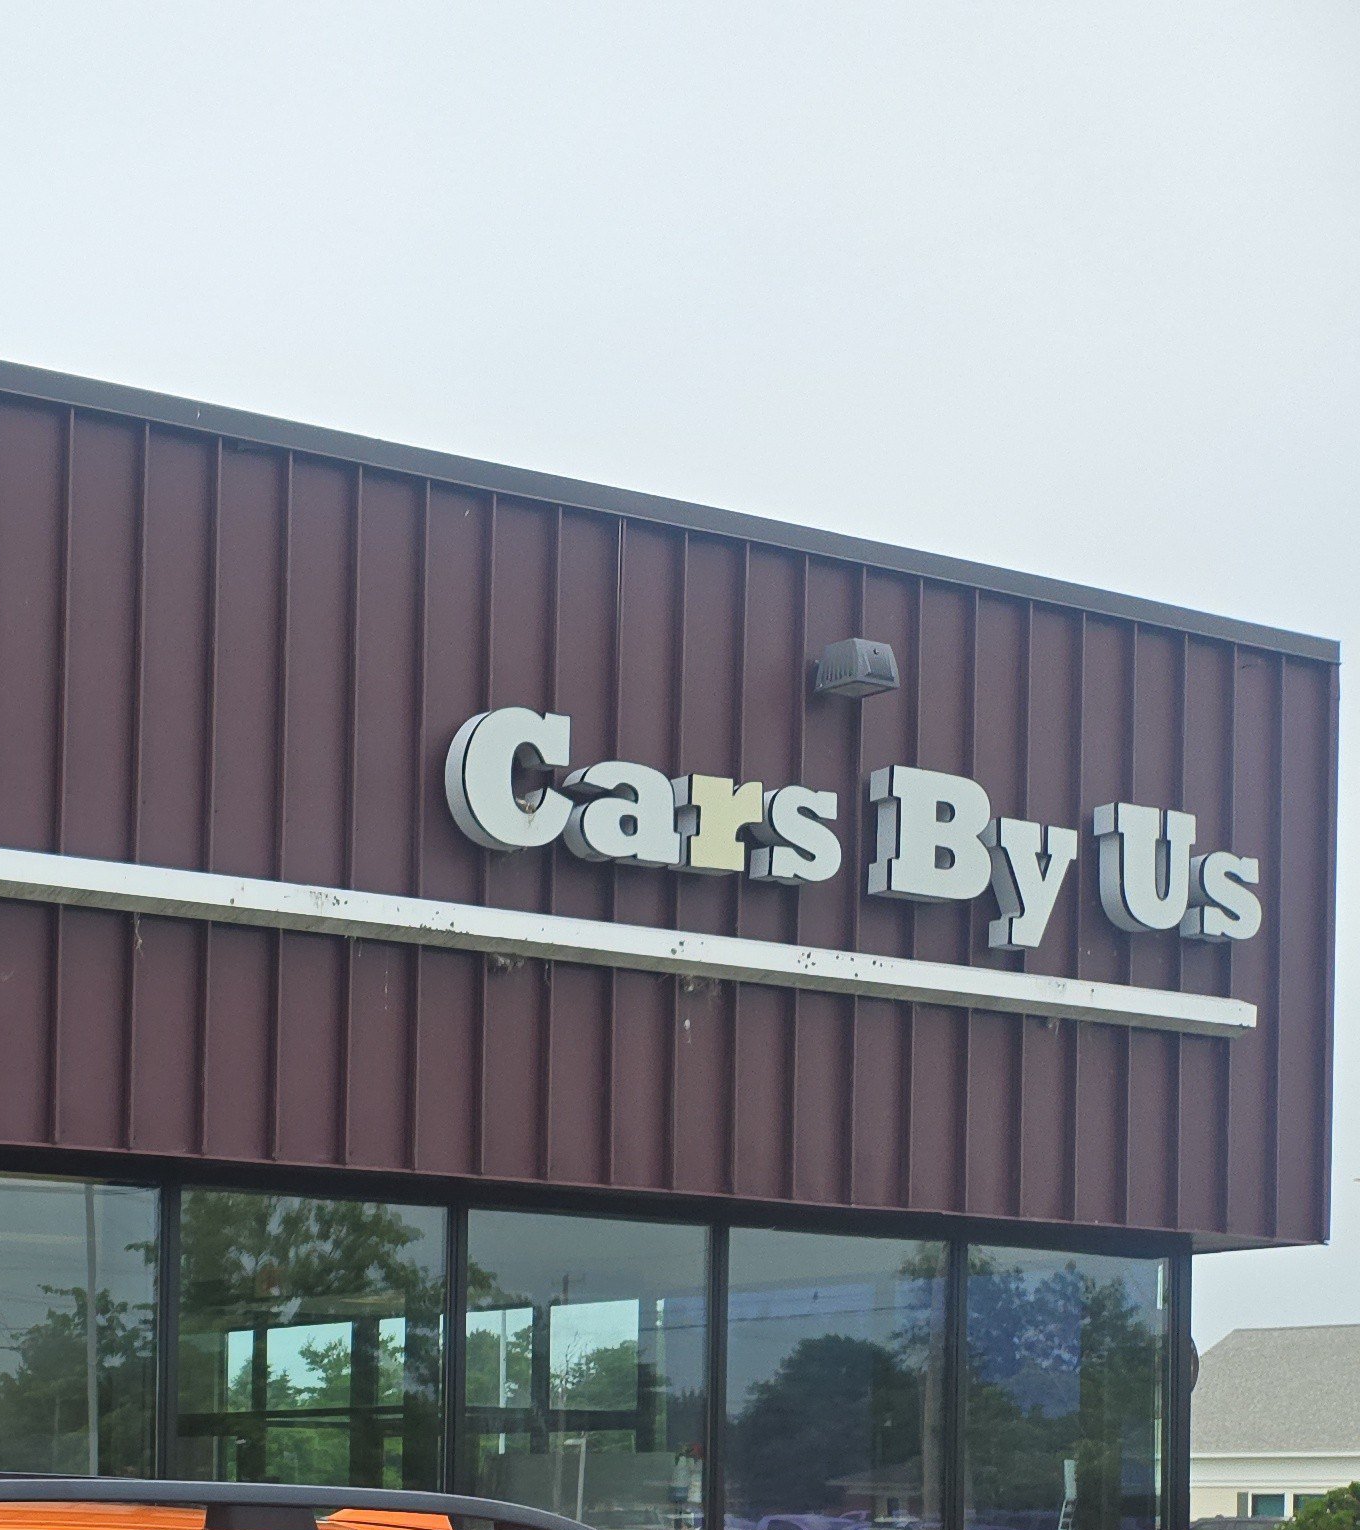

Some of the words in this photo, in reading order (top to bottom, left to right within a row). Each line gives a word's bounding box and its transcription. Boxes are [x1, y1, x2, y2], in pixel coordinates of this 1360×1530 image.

[445, 706, 843, 886] Cars
[868, 764, 1078, 951] By
[1093, 801, 1263, 944] Us
